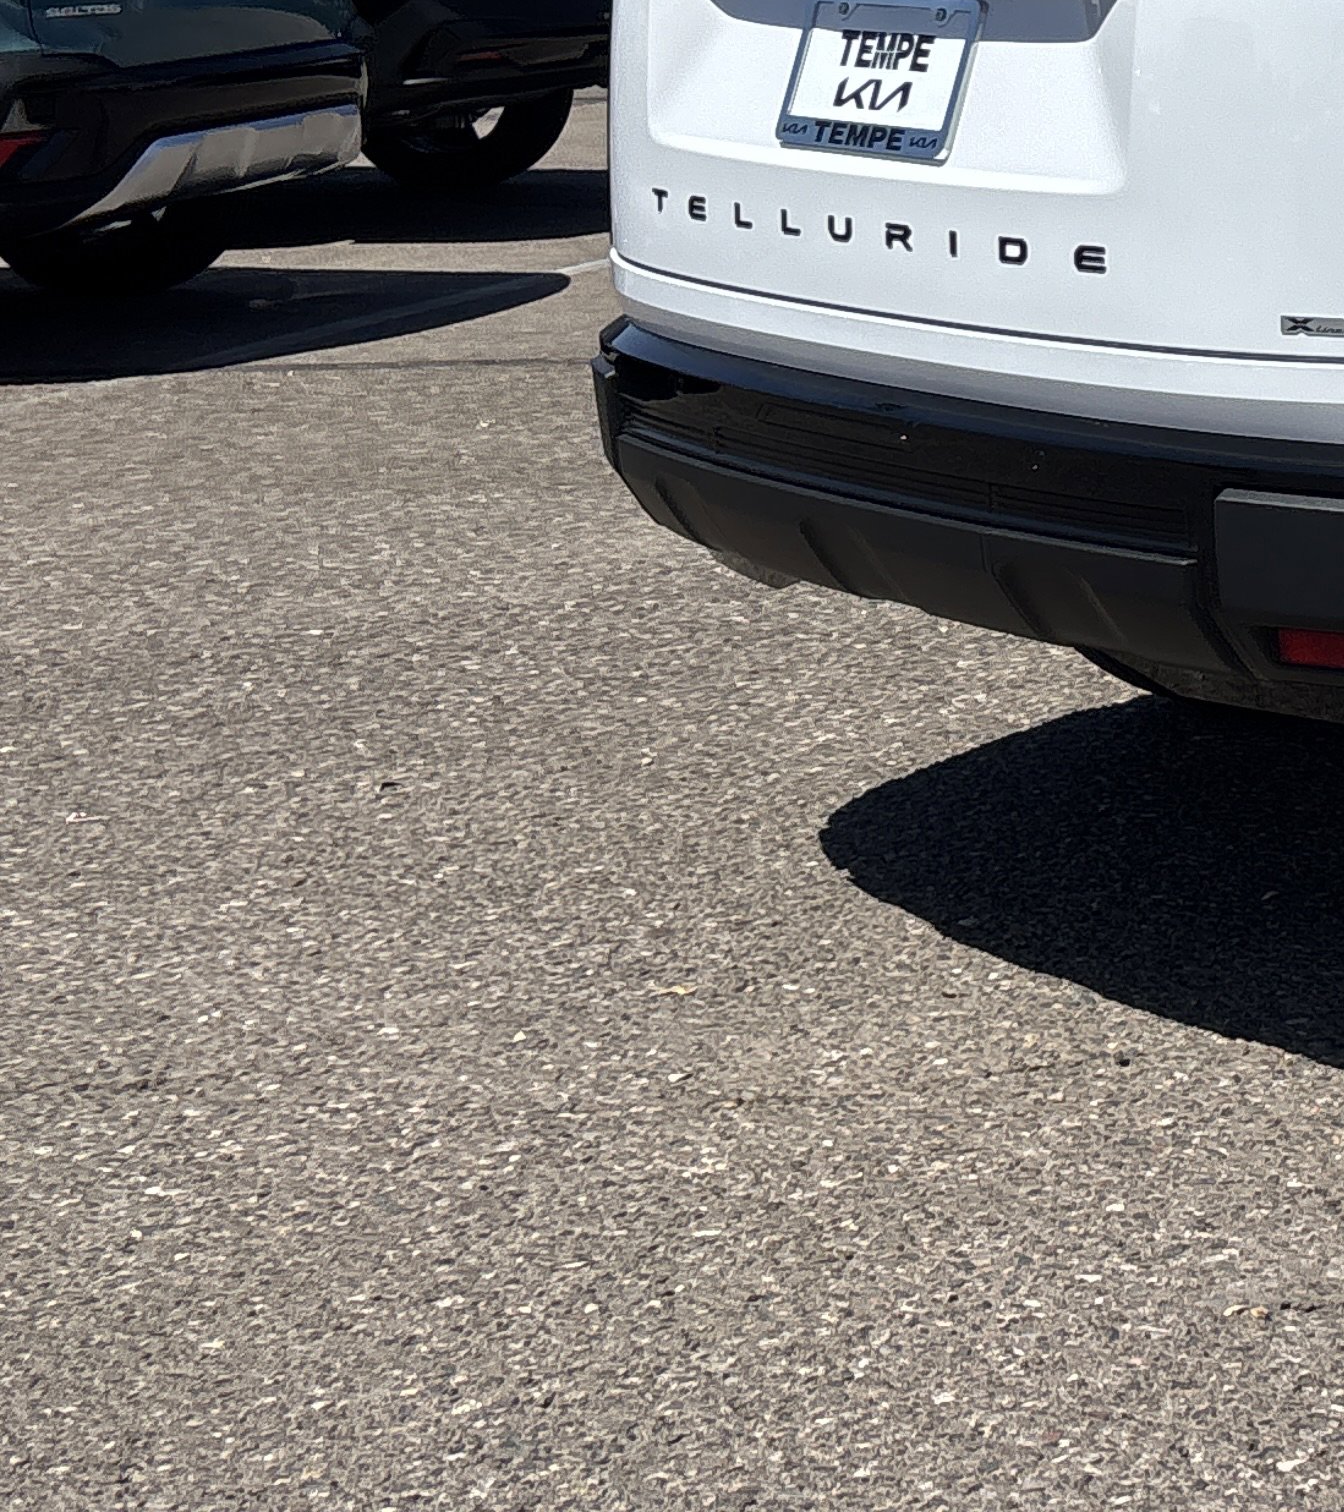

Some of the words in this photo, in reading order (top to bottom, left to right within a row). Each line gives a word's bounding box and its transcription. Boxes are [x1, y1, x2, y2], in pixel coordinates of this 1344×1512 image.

[840, 29, 937, 72] TEMPE
[833, 76, 913, 112] KIA
[813, 121, 906, 151] TEMPE
[652, 188, 1108, 275] TELLURIDE
